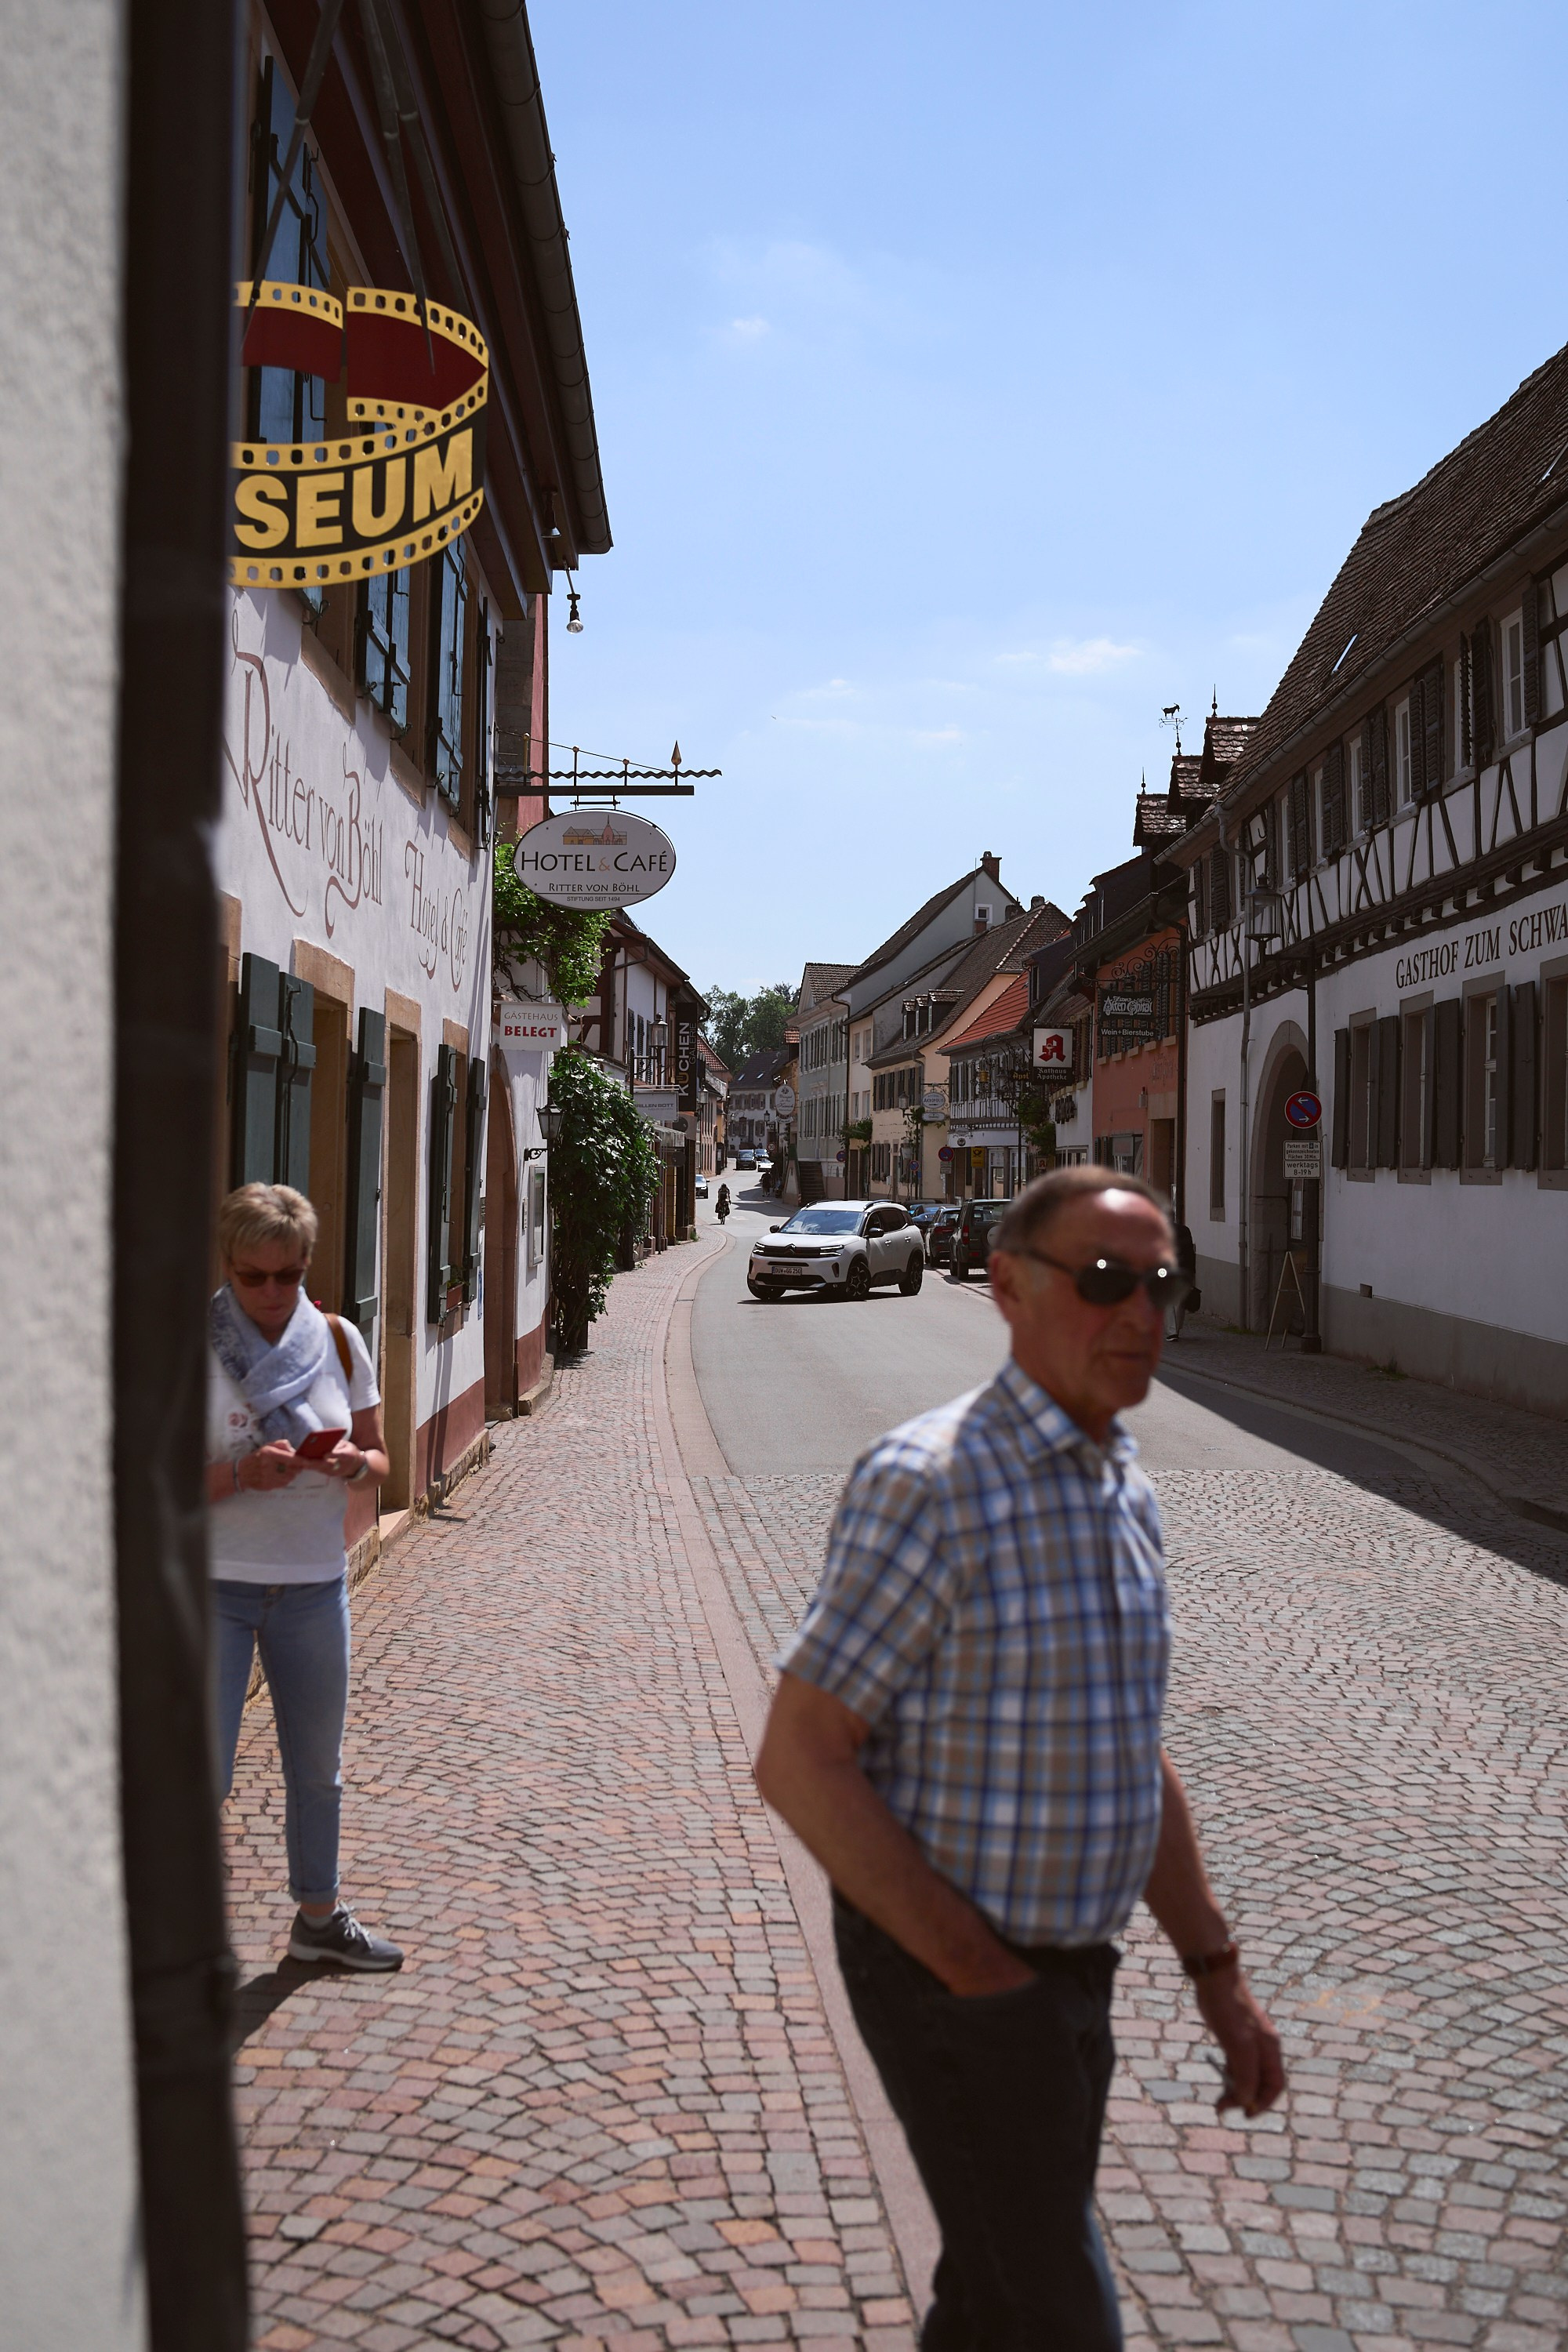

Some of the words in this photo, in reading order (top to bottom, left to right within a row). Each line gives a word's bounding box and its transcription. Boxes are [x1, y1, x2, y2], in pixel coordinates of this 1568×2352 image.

[223, 609, 314, 917] Ritter
[319, 795, 344, 879] von
[325, 742, 383, 939] Böhl
[521, 851, 596, 872] HOTEL
[598, 857, 610, 872] &
[614, 851, 667, 872] CAFÉ
[405, 840, 440, 979] Hotel
[441, 895, 448, 956] &
[451, 887, 468, 993] Café
[549, 883, 583, 892] RITTER
[612, 882, 640, 892] BÖHL
[1396, 940, 1459, 989] GASTHOF
[1464, 926, 1501, 968] ZUM
[1508, 902, 1568, 956] SCHWA
[504, 1011, 558, 1021] GÄSTEHAUS
[505, 1025, 557, 1037] BELEGT
[676, 1022, 690, 1097] KÜCHEN
